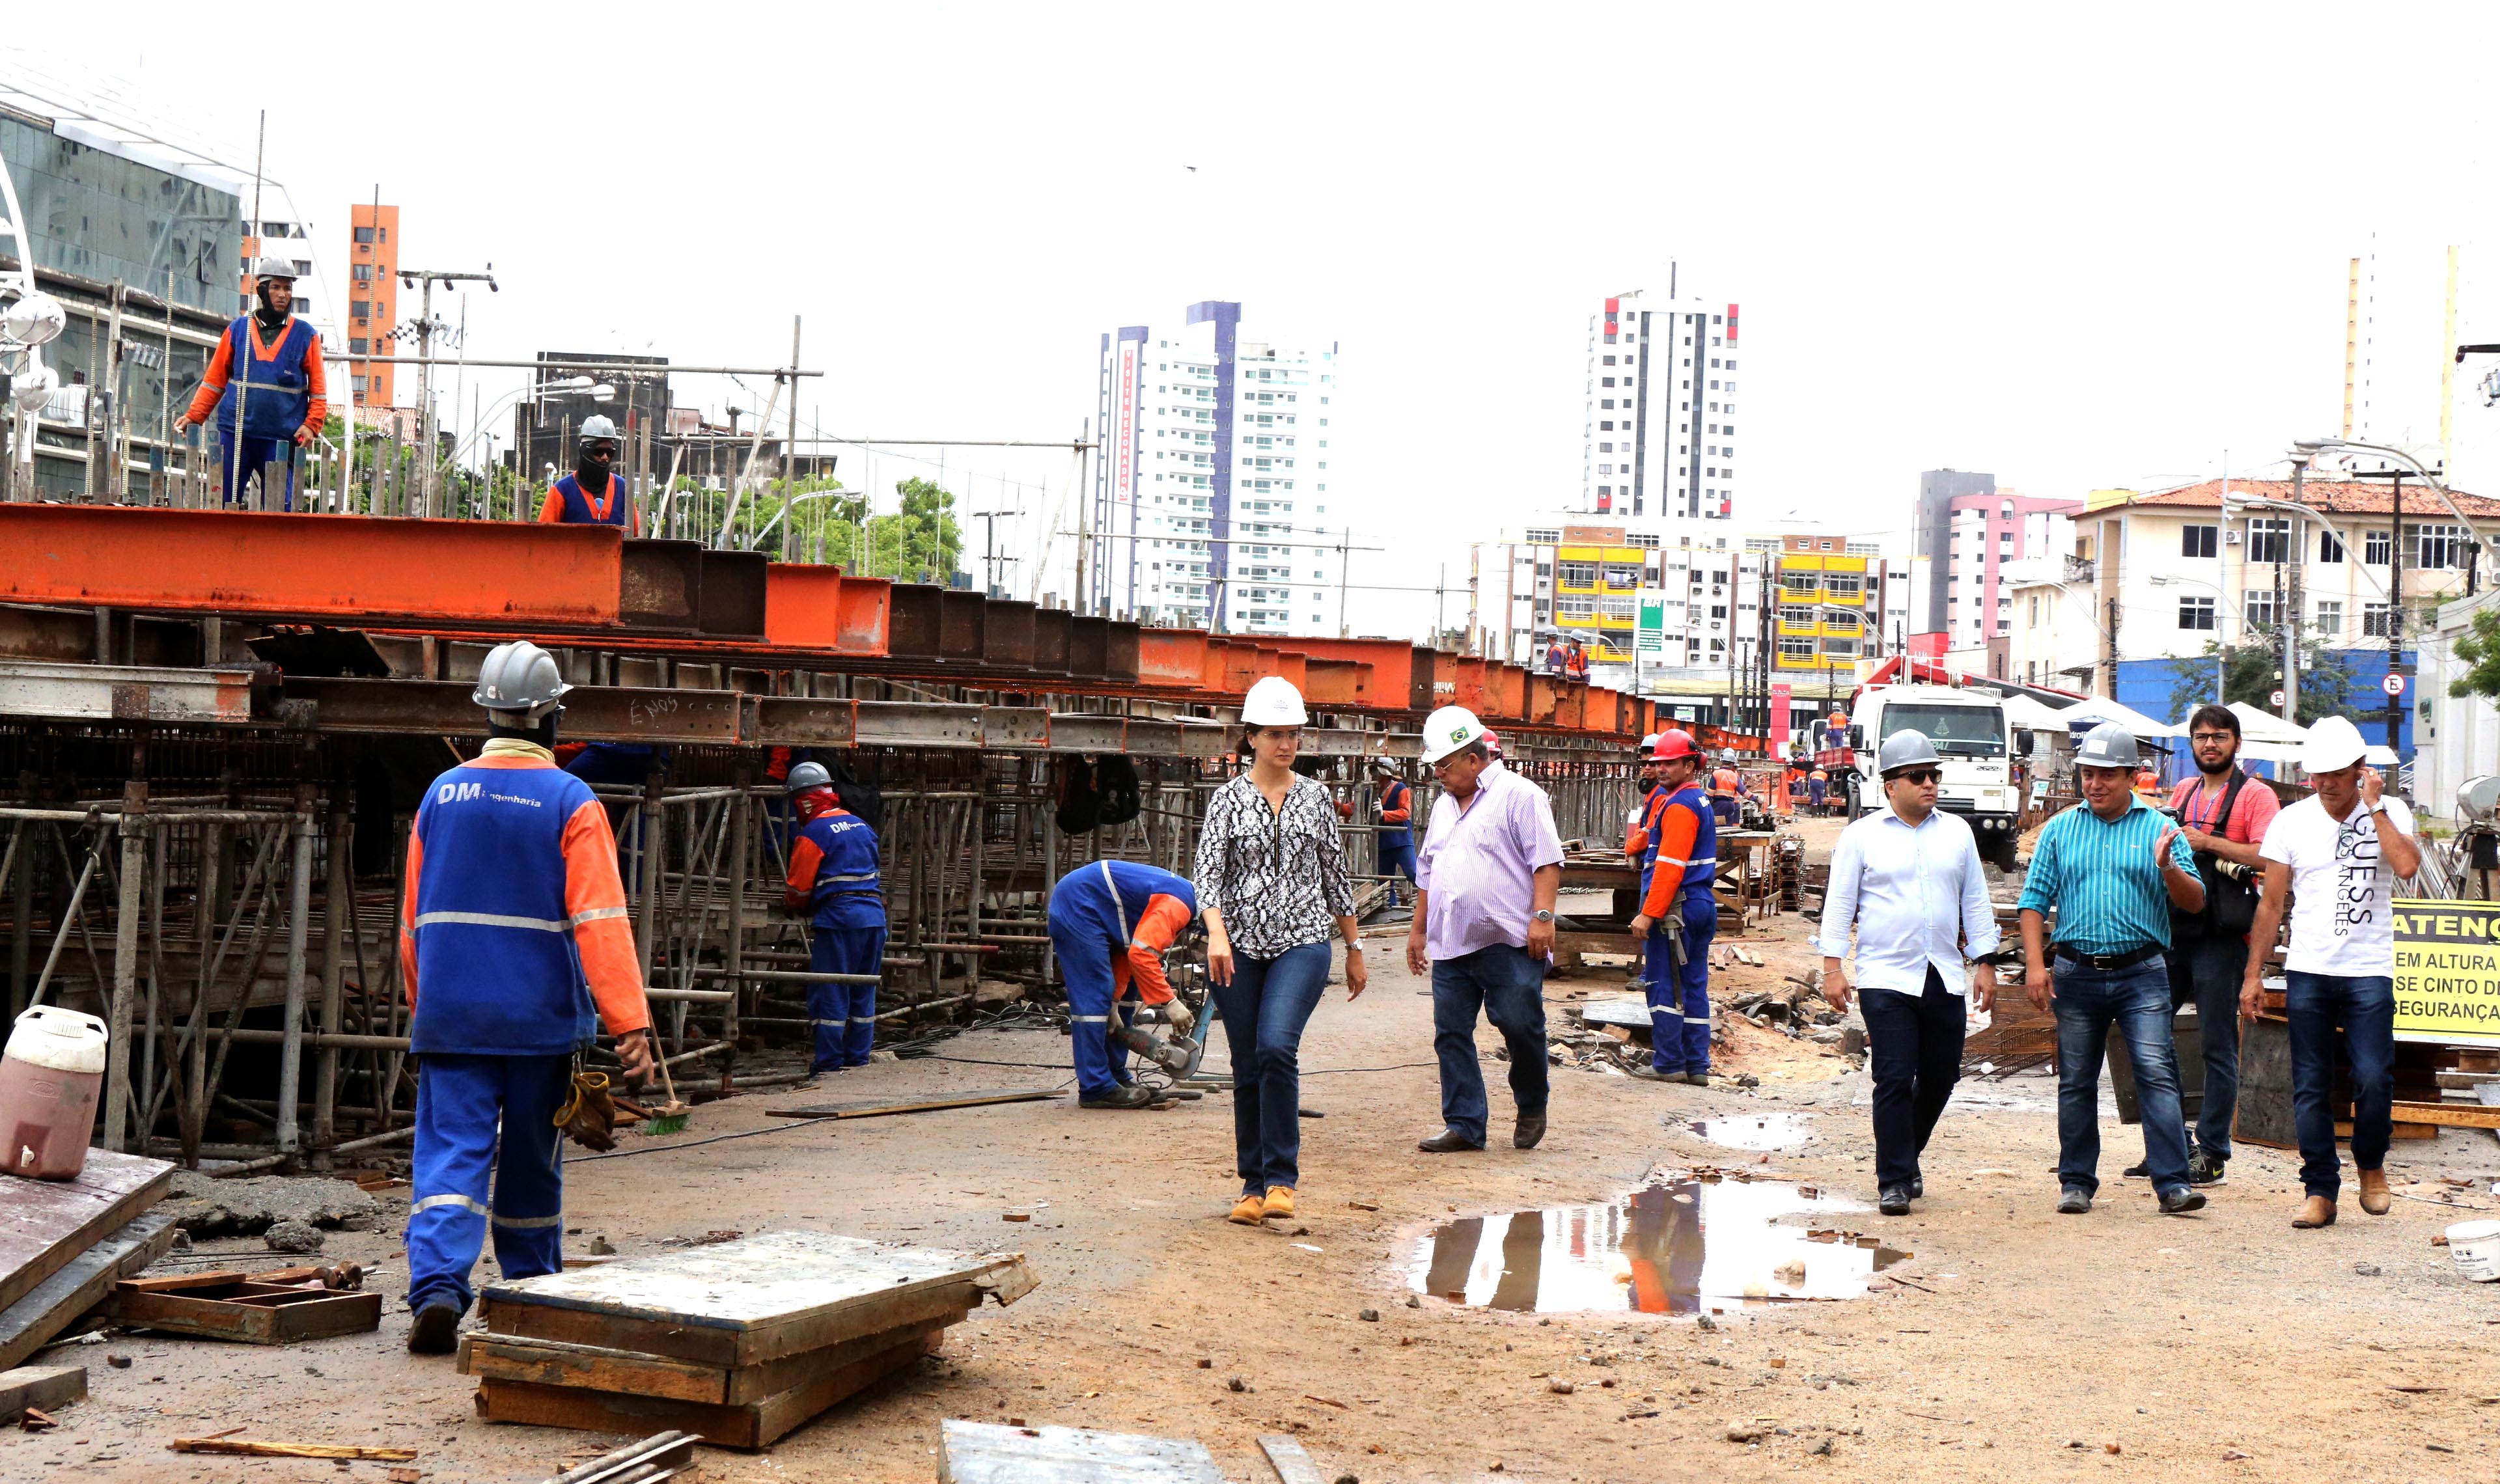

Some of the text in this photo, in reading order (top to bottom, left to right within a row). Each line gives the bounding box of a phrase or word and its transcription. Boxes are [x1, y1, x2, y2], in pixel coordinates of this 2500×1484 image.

[1121, 410, 1130, 484] DECORADO
[1643, 598, 1661, 608] BR
[438, 782, 482, 804] DM
[829, 821, 850, 834] DM
[2348, 814, 2379, 924] GUESS
[2335, 864, 2351, 936] ANGELES
[2396, 952, 2497, 971] EM ALTURA
[2424, 977, 2478, 995] CINTO
